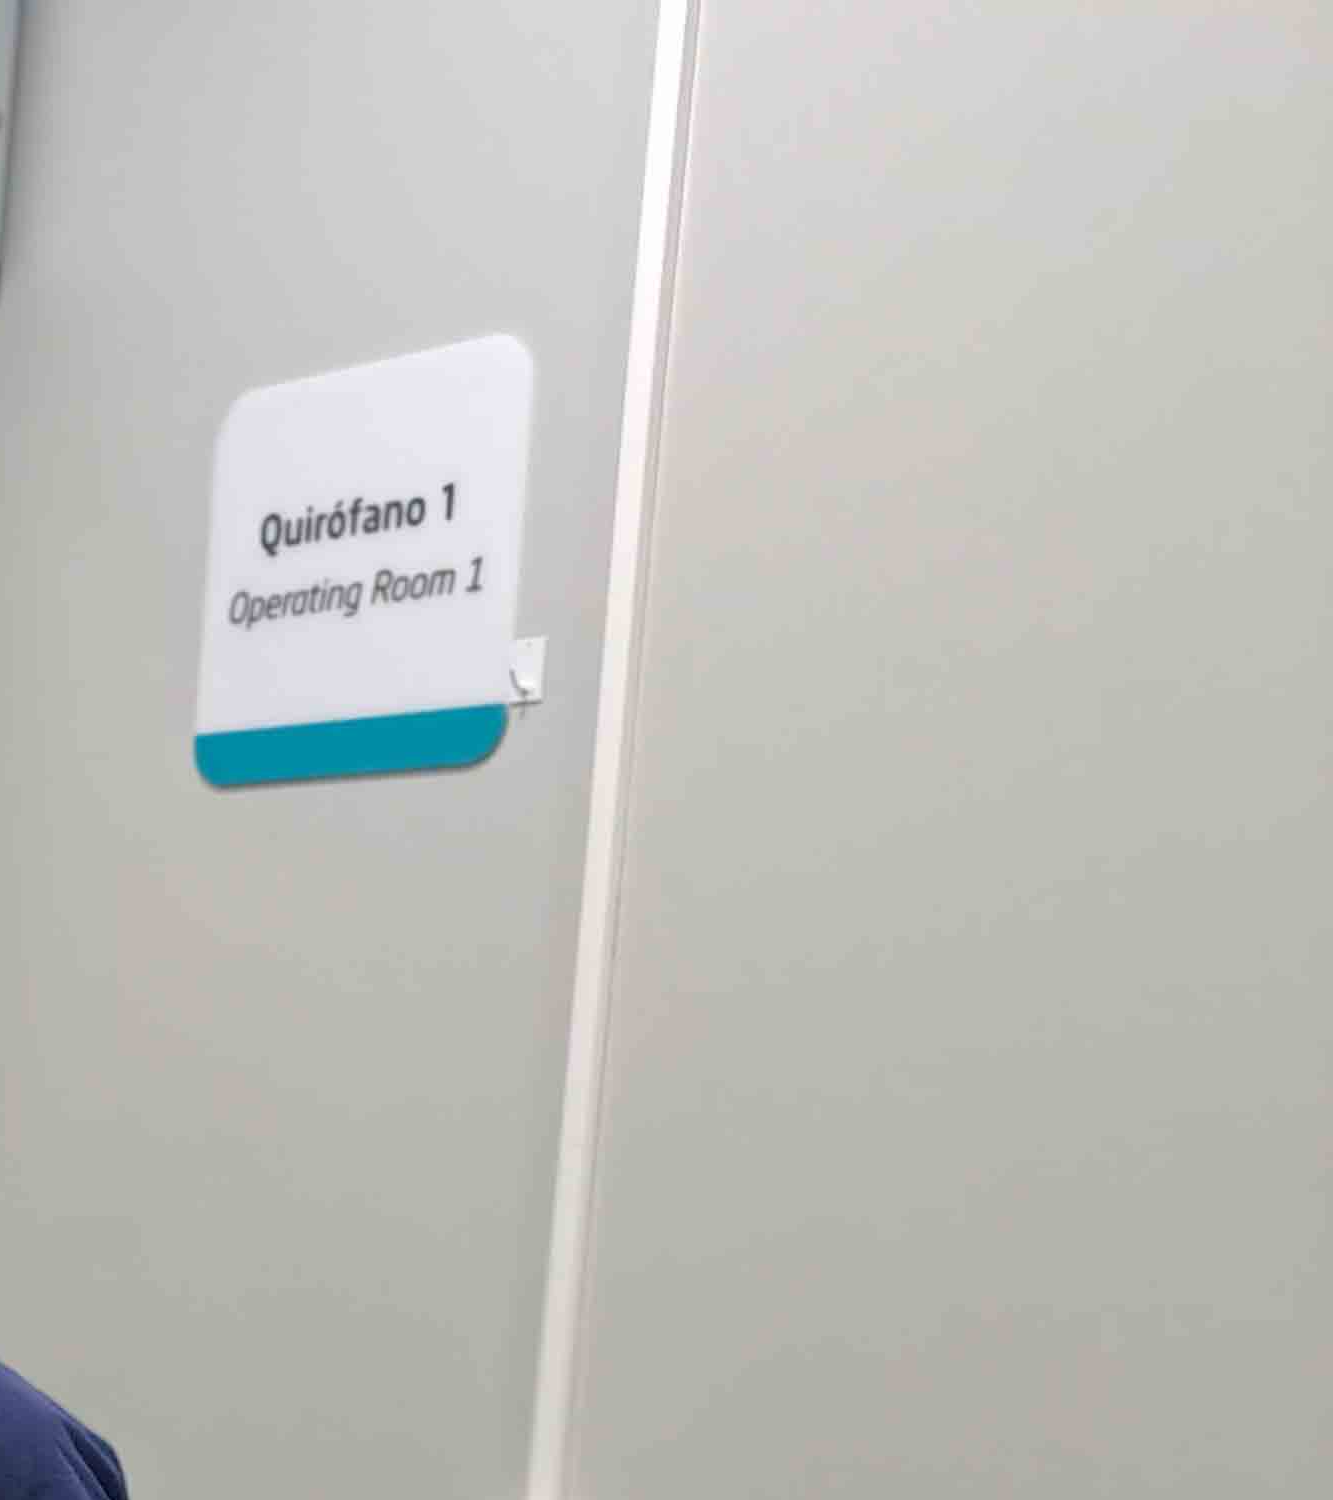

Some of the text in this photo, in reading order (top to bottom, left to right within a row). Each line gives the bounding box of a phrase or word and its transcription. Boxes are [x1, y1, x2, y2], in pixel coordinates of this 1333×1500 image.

[261, 483, 456, 556] Quirófano 1
[229, 556, 483, 628] Operating Room 1
